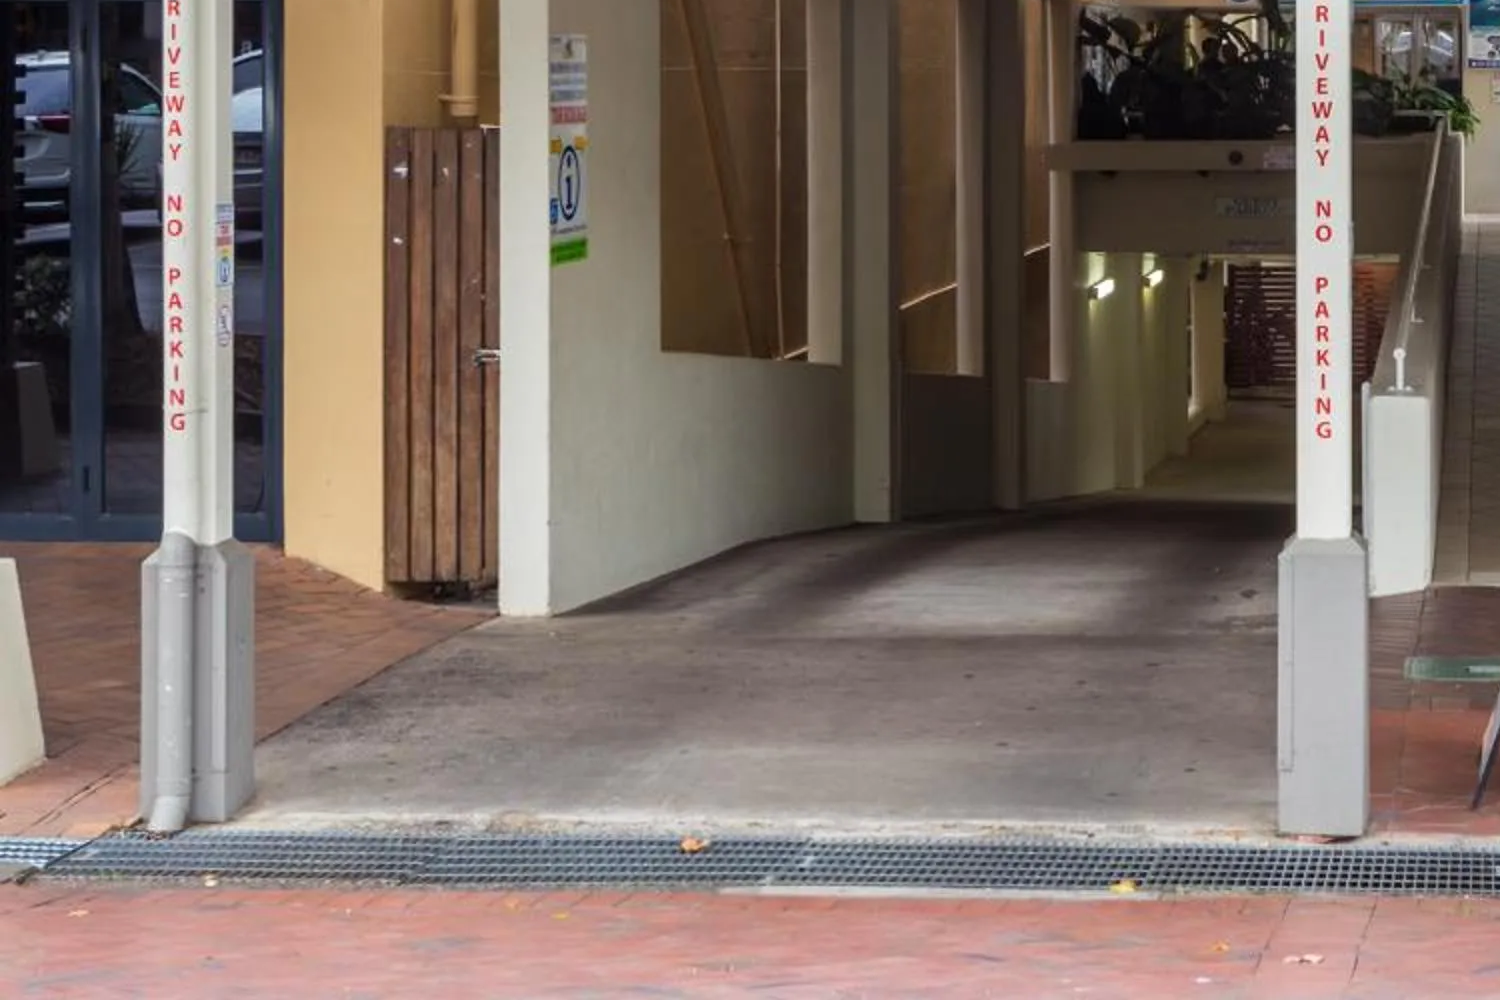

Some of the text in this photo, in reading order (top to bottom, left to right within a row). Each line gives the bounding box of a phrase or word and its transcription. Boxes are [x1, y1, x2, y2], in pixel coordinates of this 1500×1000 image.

[166, 195, 184, 237] NO
[1315, 200, 1333, 243] NO
[167, 268, 187, 432] PARKING
[1314, 276, 1333, 440] PARKING
